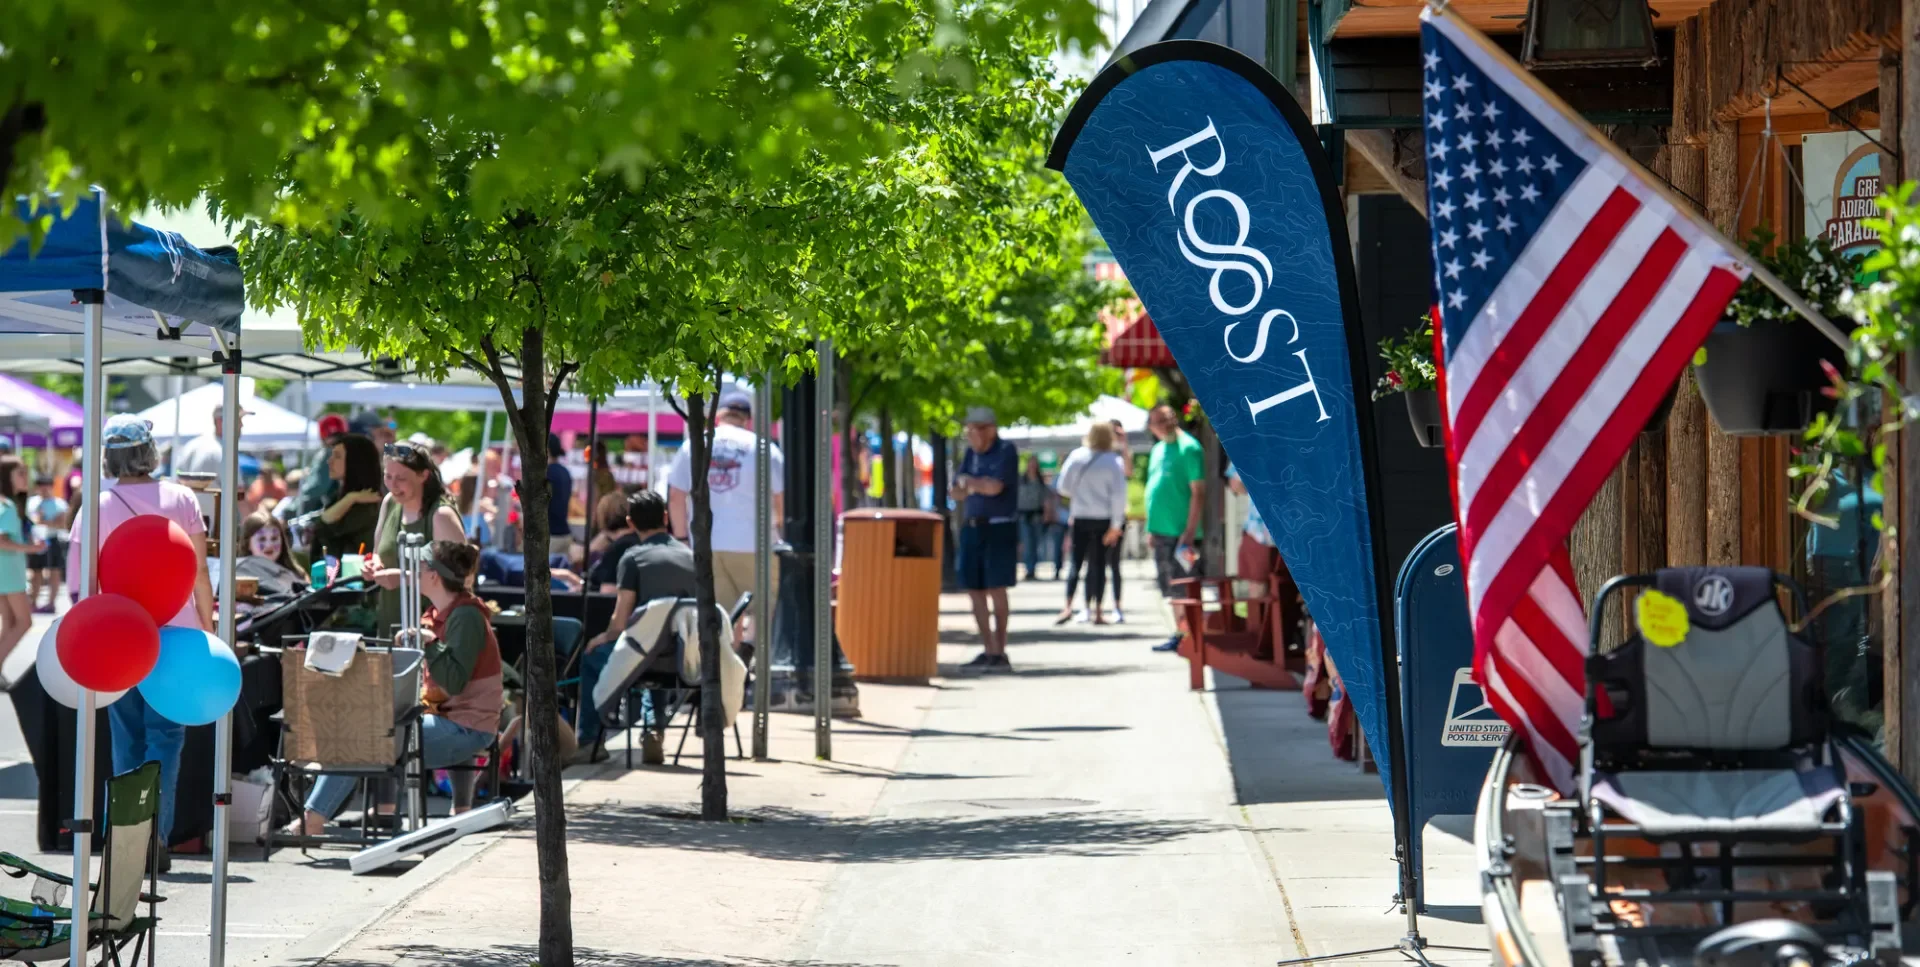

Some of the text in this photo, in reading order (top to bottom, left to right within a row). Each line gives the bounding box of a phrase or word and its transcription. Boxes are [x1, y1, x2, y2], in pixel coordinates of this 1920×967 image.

[1145, 115, 1331, 425] ROOST
[1449, 724, 1511, 732] UNITED STATE
[1447, 734, 1480, 742] POSTAL
